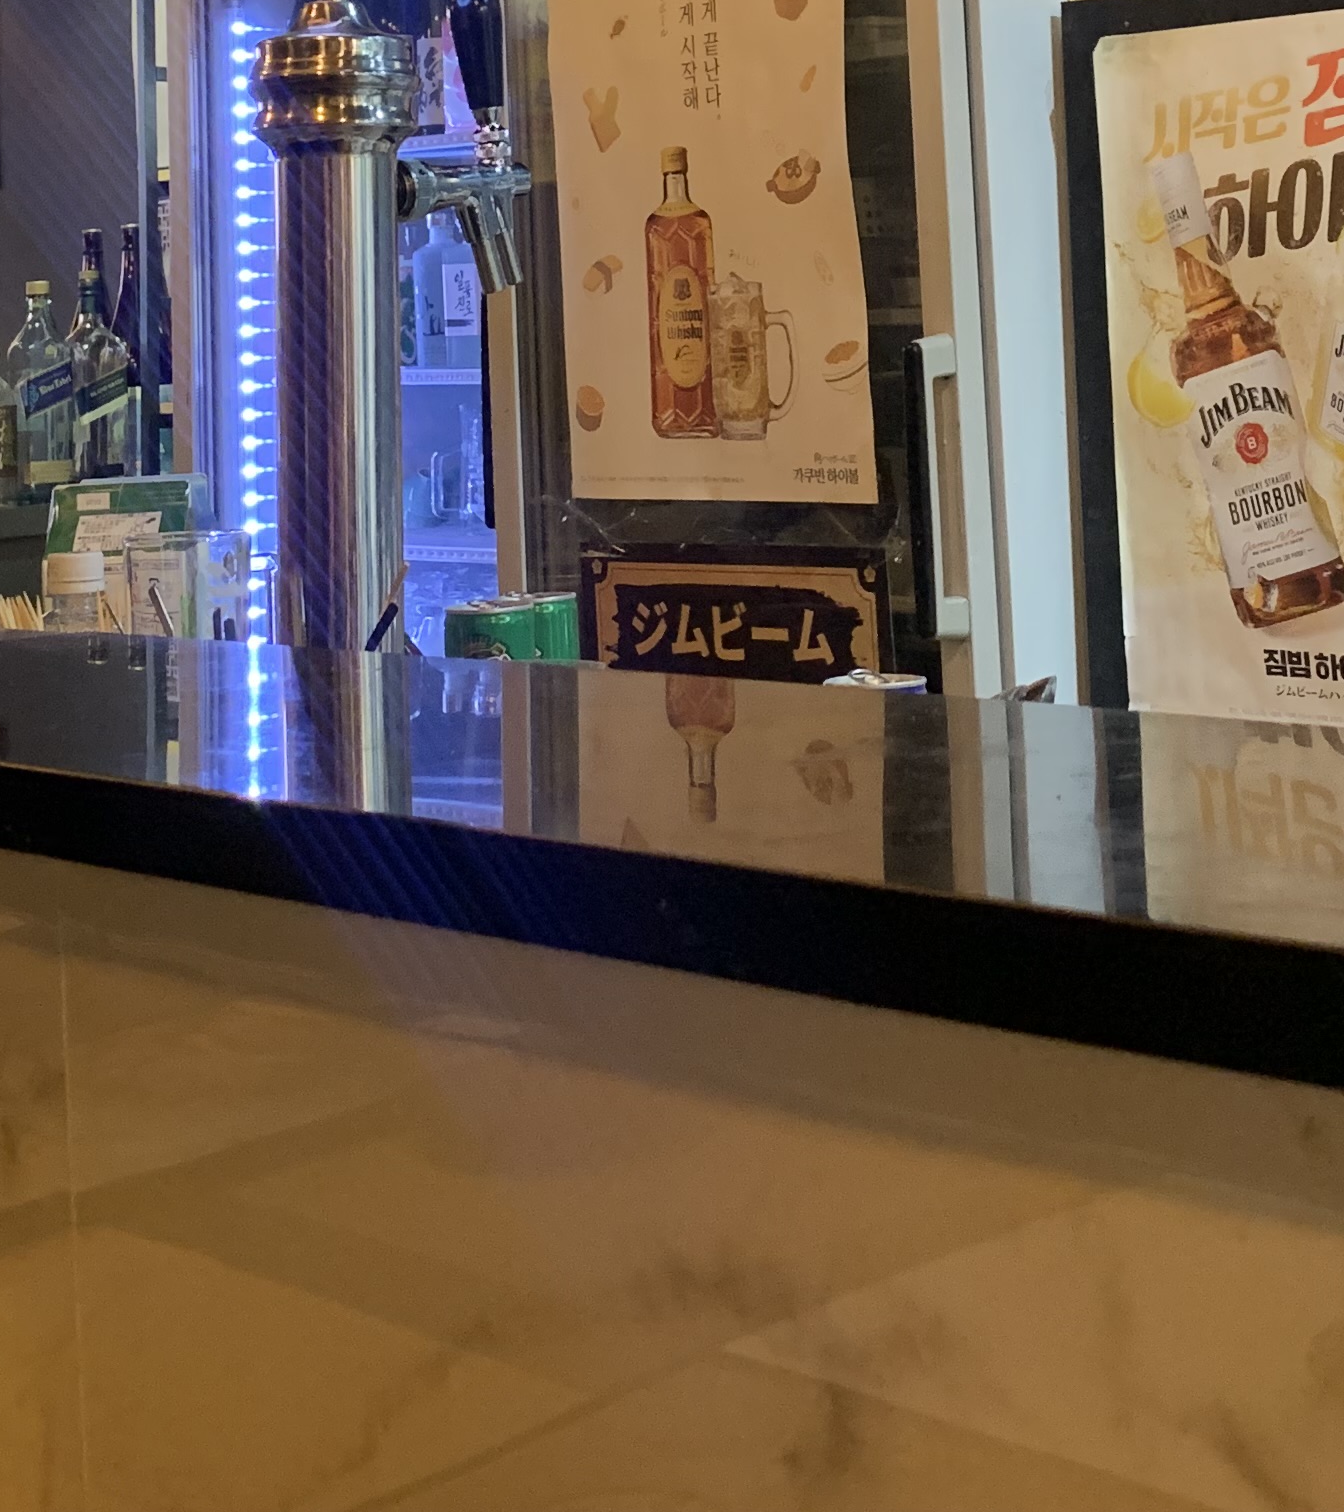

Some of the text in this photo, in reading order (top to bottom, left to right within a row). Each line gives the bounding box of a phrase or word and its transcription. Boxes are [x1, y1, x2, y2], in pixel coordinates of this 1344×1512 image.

[680, 35, 699, 110] 시작해
[1143, 74, 1292, 165] 시작은
[1198, 382, 1296, 449] JIM BEAM
[792, 466, 860, 485] 가쿠빈 하이볼
[1264, 471, 1292, 488] STRAIGHT
[1228, 479, 1309, 526] BOURBON
[1255, 511, 1289, 532] WHISKEY
[631, 601, 835, 667] ジムビーム
[1263, 648, 1312, 680] 짐빔
